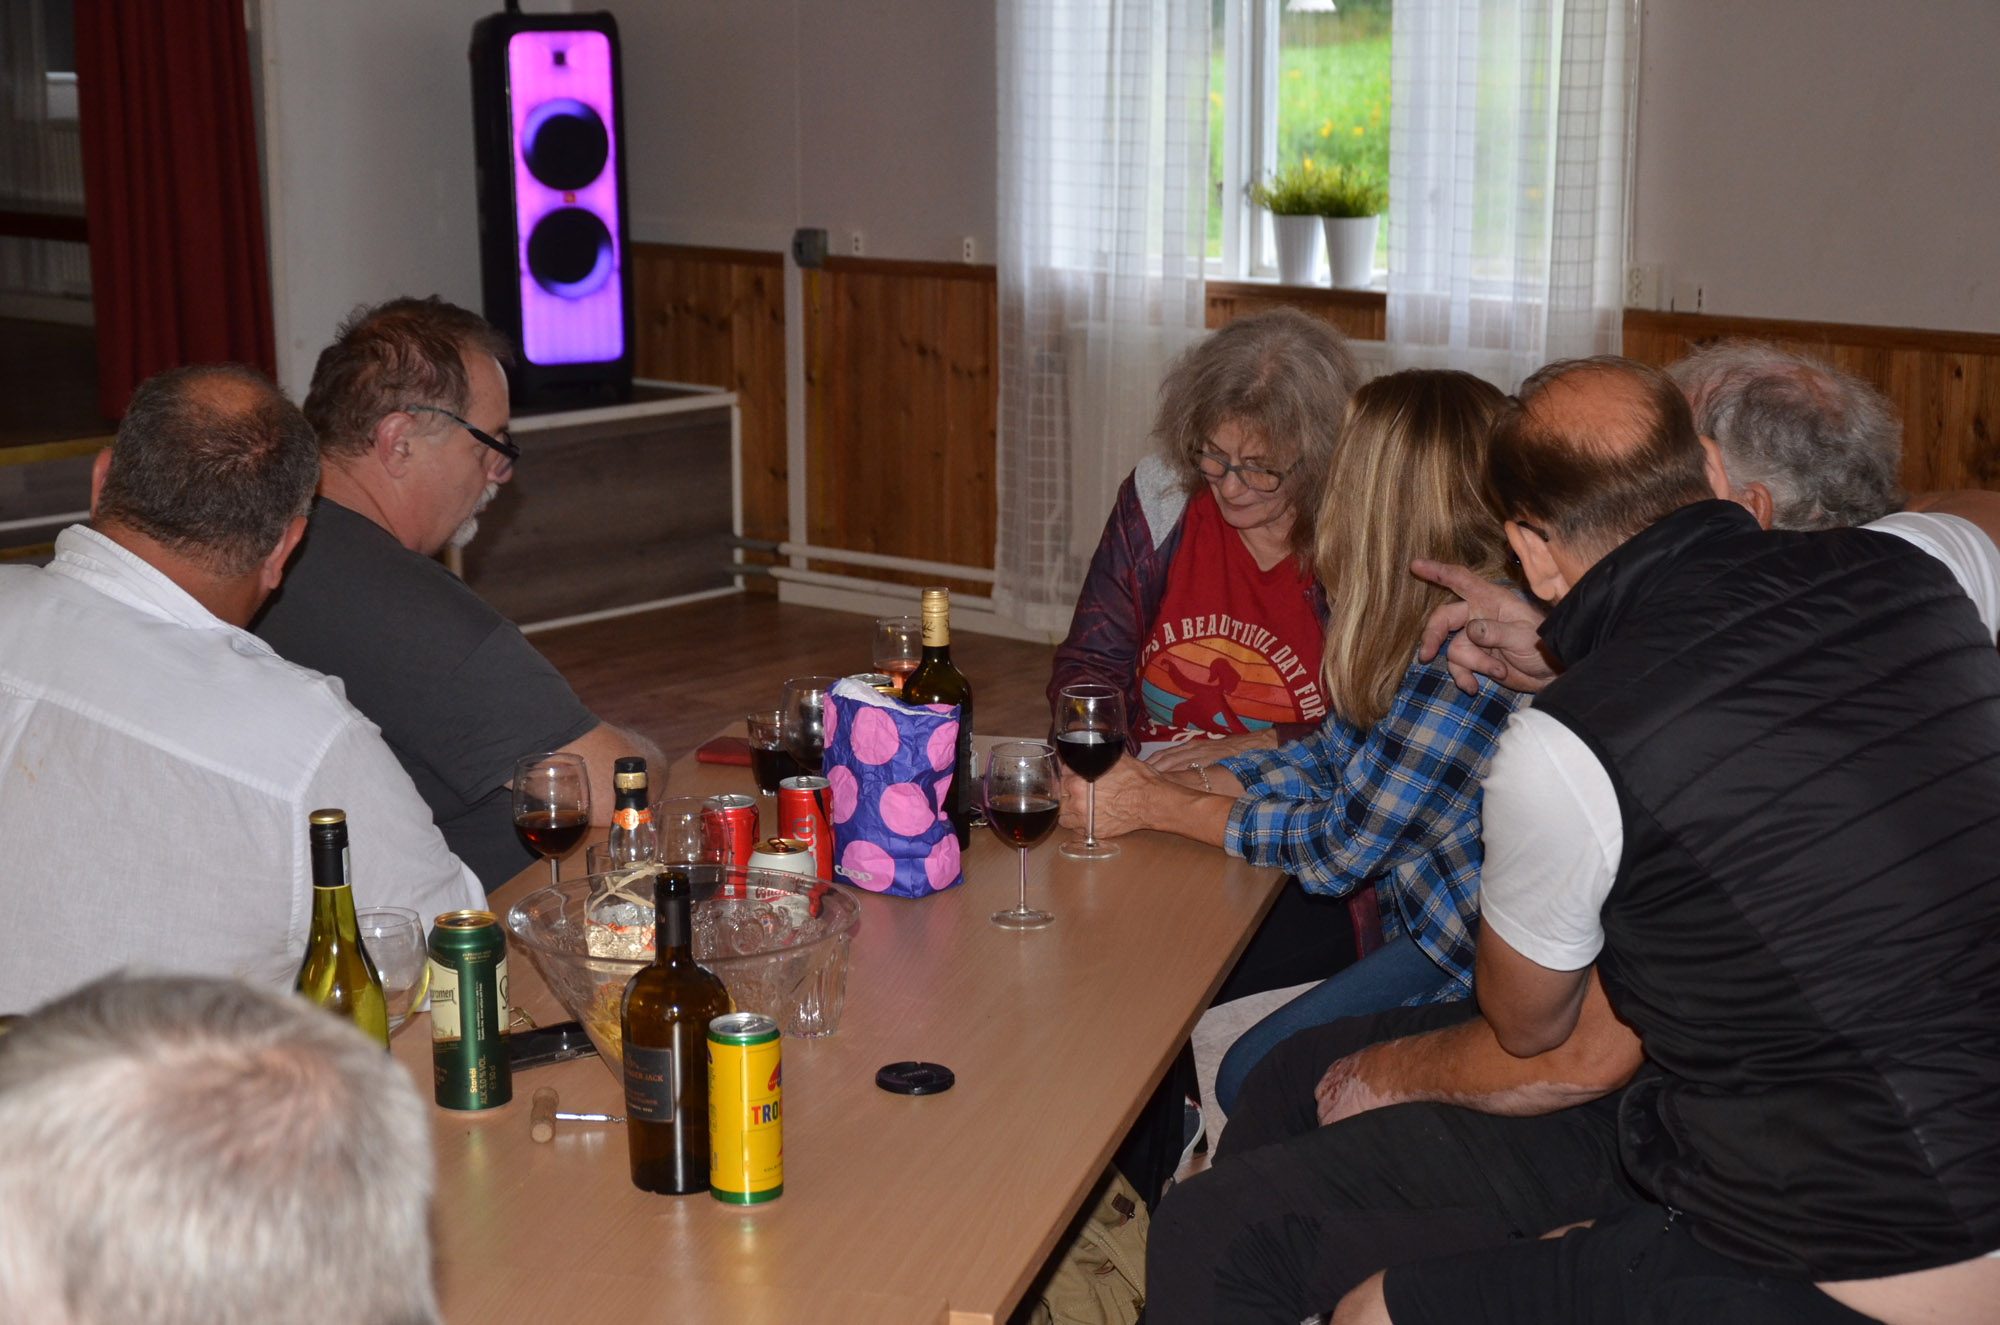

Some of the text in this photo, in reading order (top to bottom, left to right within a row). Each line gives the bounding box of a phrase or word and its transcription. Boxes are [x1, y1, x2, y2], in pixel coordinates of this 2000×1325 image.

[1163, 622, 1177, 645] A
[1181, 614, 1278, 655] BEAUTIFUL
[1270, 644, 1307, 683] DAY
[1294, 681, 1326, 721] FOR
[834, 864, 873, 882] coop
